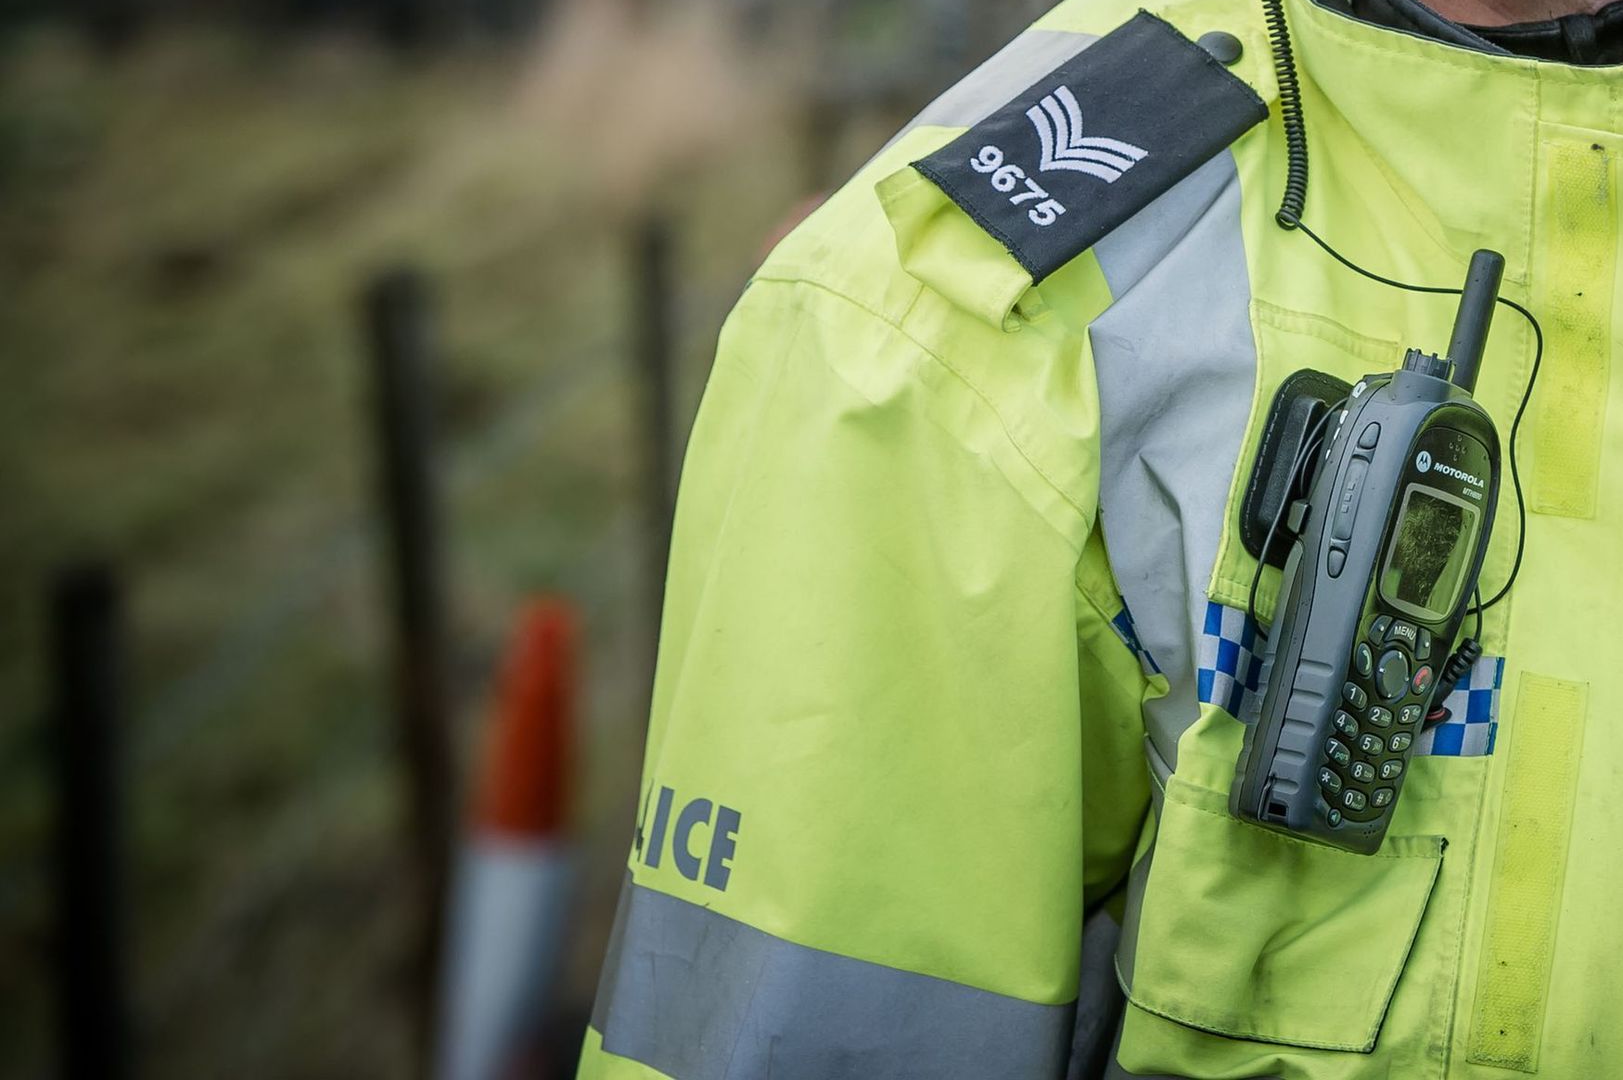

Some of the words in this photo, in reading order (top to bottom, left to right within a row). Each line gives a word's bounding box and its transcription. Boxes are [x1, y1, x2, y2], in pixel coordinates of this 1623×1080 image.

[970, 145, 1066, 227] 9675
[1434, 462, 1484, 488] MOTOROLA
[1394, 625, 1416, 640] MENU
[1350, 687, 1357, 700] 1
[1337, 714, 1346, 727] 4
[1371, 708, 1380, 721] 2
[1402, 709, 1410, 722] 3
[1329, 741, 1338, 754] 7
[1362, 737, 1372, 750] 5
[1392, 737, 1401, 749] 6
[1354, 765, 1363, 778] 8
[1382, 765, 1391, 777] 9
[1344, 792, 1353, 805] 0
[636, 780, 742, 892] ICE
